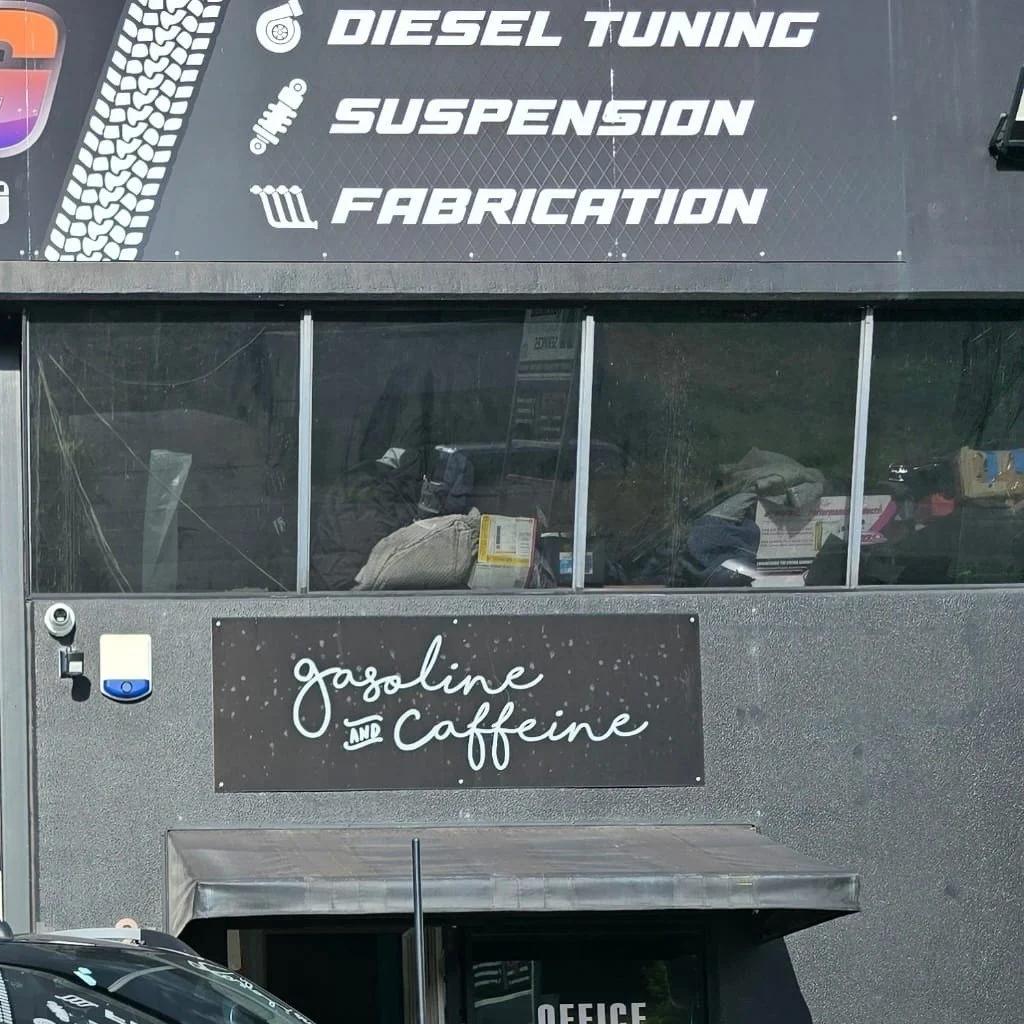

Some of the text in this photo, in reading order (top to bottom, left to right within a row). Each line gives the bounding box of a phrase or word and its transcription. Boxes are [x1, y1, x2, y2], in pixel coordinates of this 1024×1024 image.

[327, 9, 819, 47] DIESEL TUNING
[329, 98, 755, 136] SUSPENSION
[330, 188, 768, 225] FABRICATION
[293, 634, 544, 738] gasoline
[348, 723, 381, 745] AND
